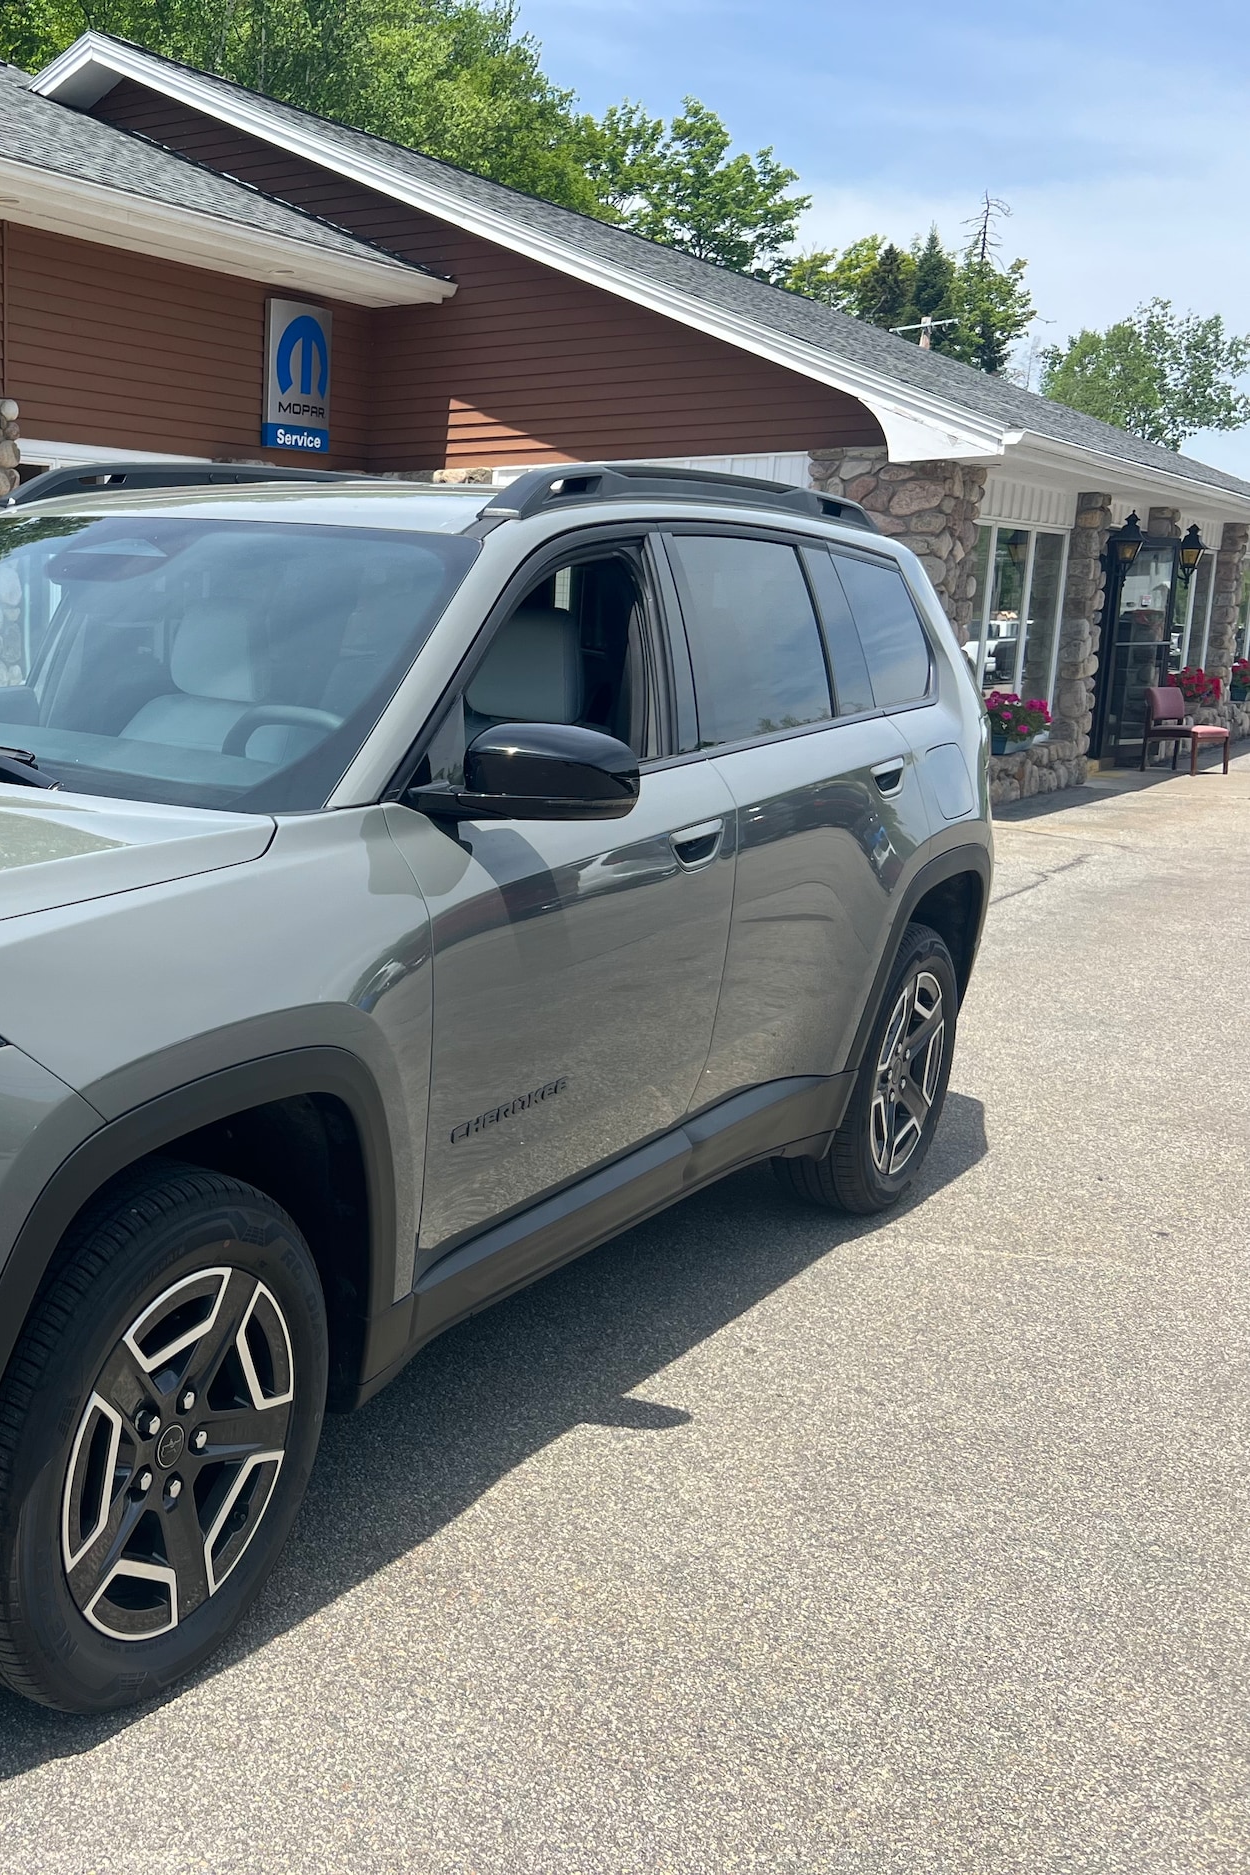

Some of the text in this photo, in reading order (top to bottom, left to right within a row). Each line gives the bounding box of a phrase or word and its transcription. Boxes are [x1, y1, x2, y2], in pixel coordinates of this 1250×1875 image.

[278, 401, 325, 418] MOPAR
[276, 429, 321, 448] Service
[450, 1075, 569, 1143] CHEROKEE
